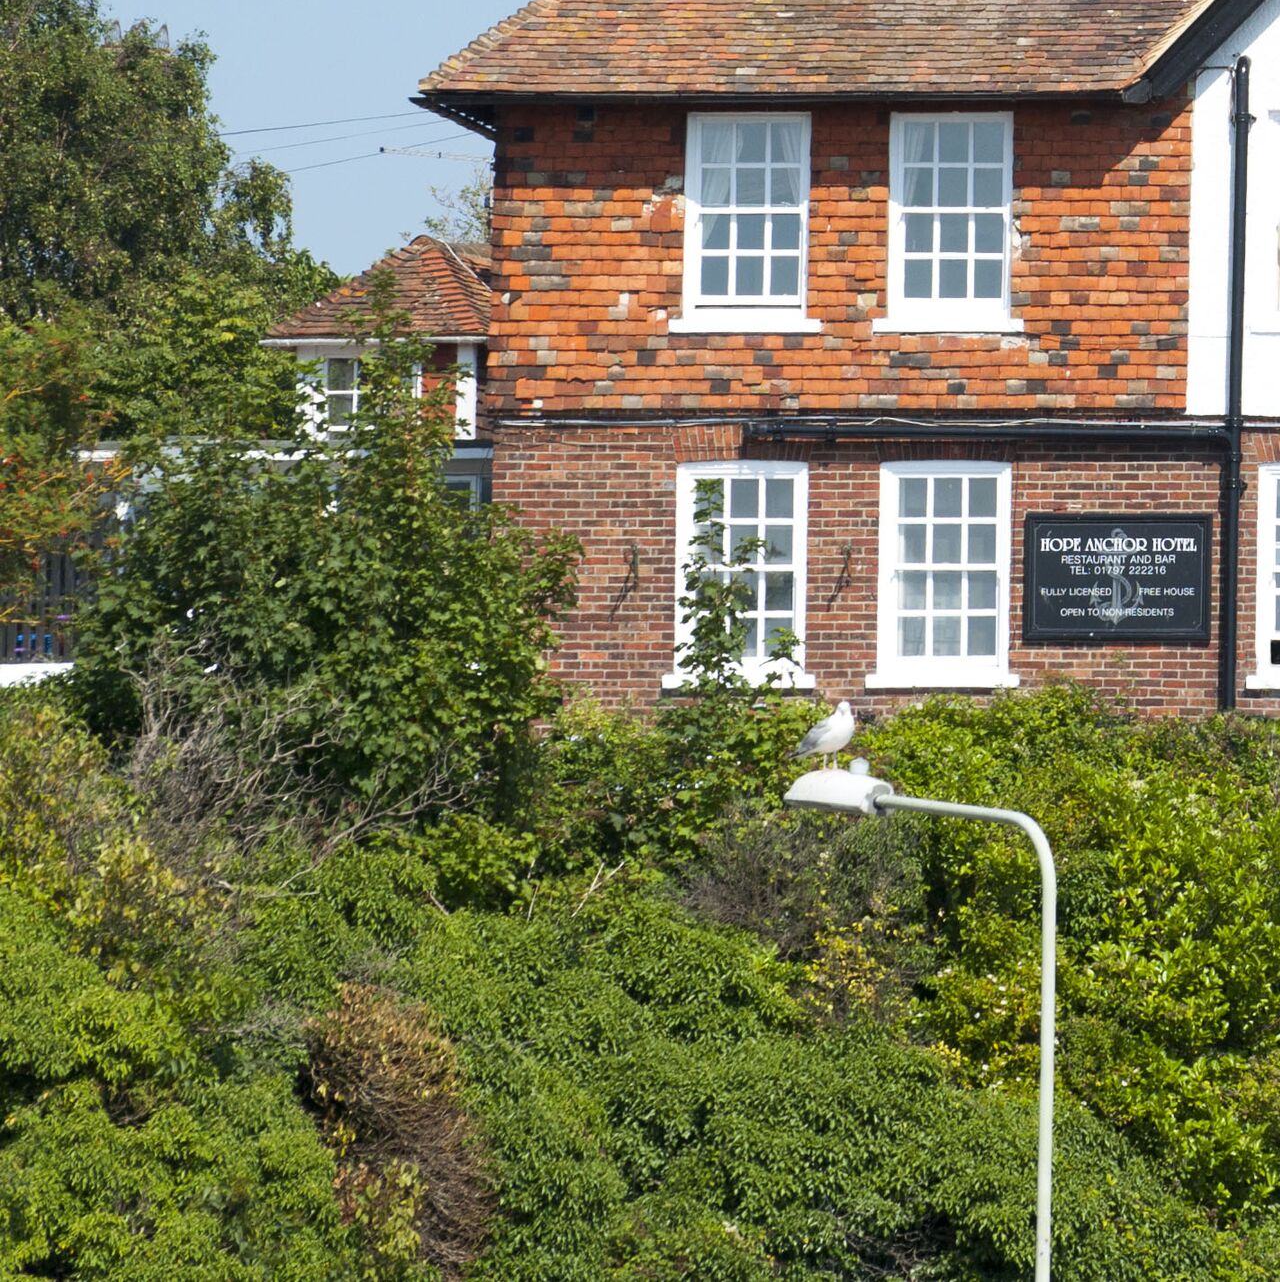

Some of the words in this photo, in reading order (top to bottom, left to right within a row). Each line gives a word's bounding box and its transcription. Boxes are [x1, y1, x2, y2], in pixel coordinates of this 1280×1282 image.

[1040, 538, 1081, 552] HOPE
[1085, 538, 1148, 552] ANCHOR
[1152, 537, 1198, 552] HOTEL
[1061, 554, 1127, 565] RESTAURANT
[1130, 554, 1152, 565] AND
[1154, 554, 1176, 565] BAR
[1070, 565, 1091, 575] TEL:
[1094, 565, 1125, 575] 01797
[1128, 565, 1167, 575] 222216
[1041, 587, 1067, 596] FULLY
[1069, 587, 1112, 596] LICENSED
[1139, 587, 1161, 596] FREE
[1163, 587, 1195, 596] HOUSE
[1060, 608, 1085, 617] OPEN
[1087, 608, 1100, 617] TO
[1101, 608, 1175, 617] NON-RESIDENTS
